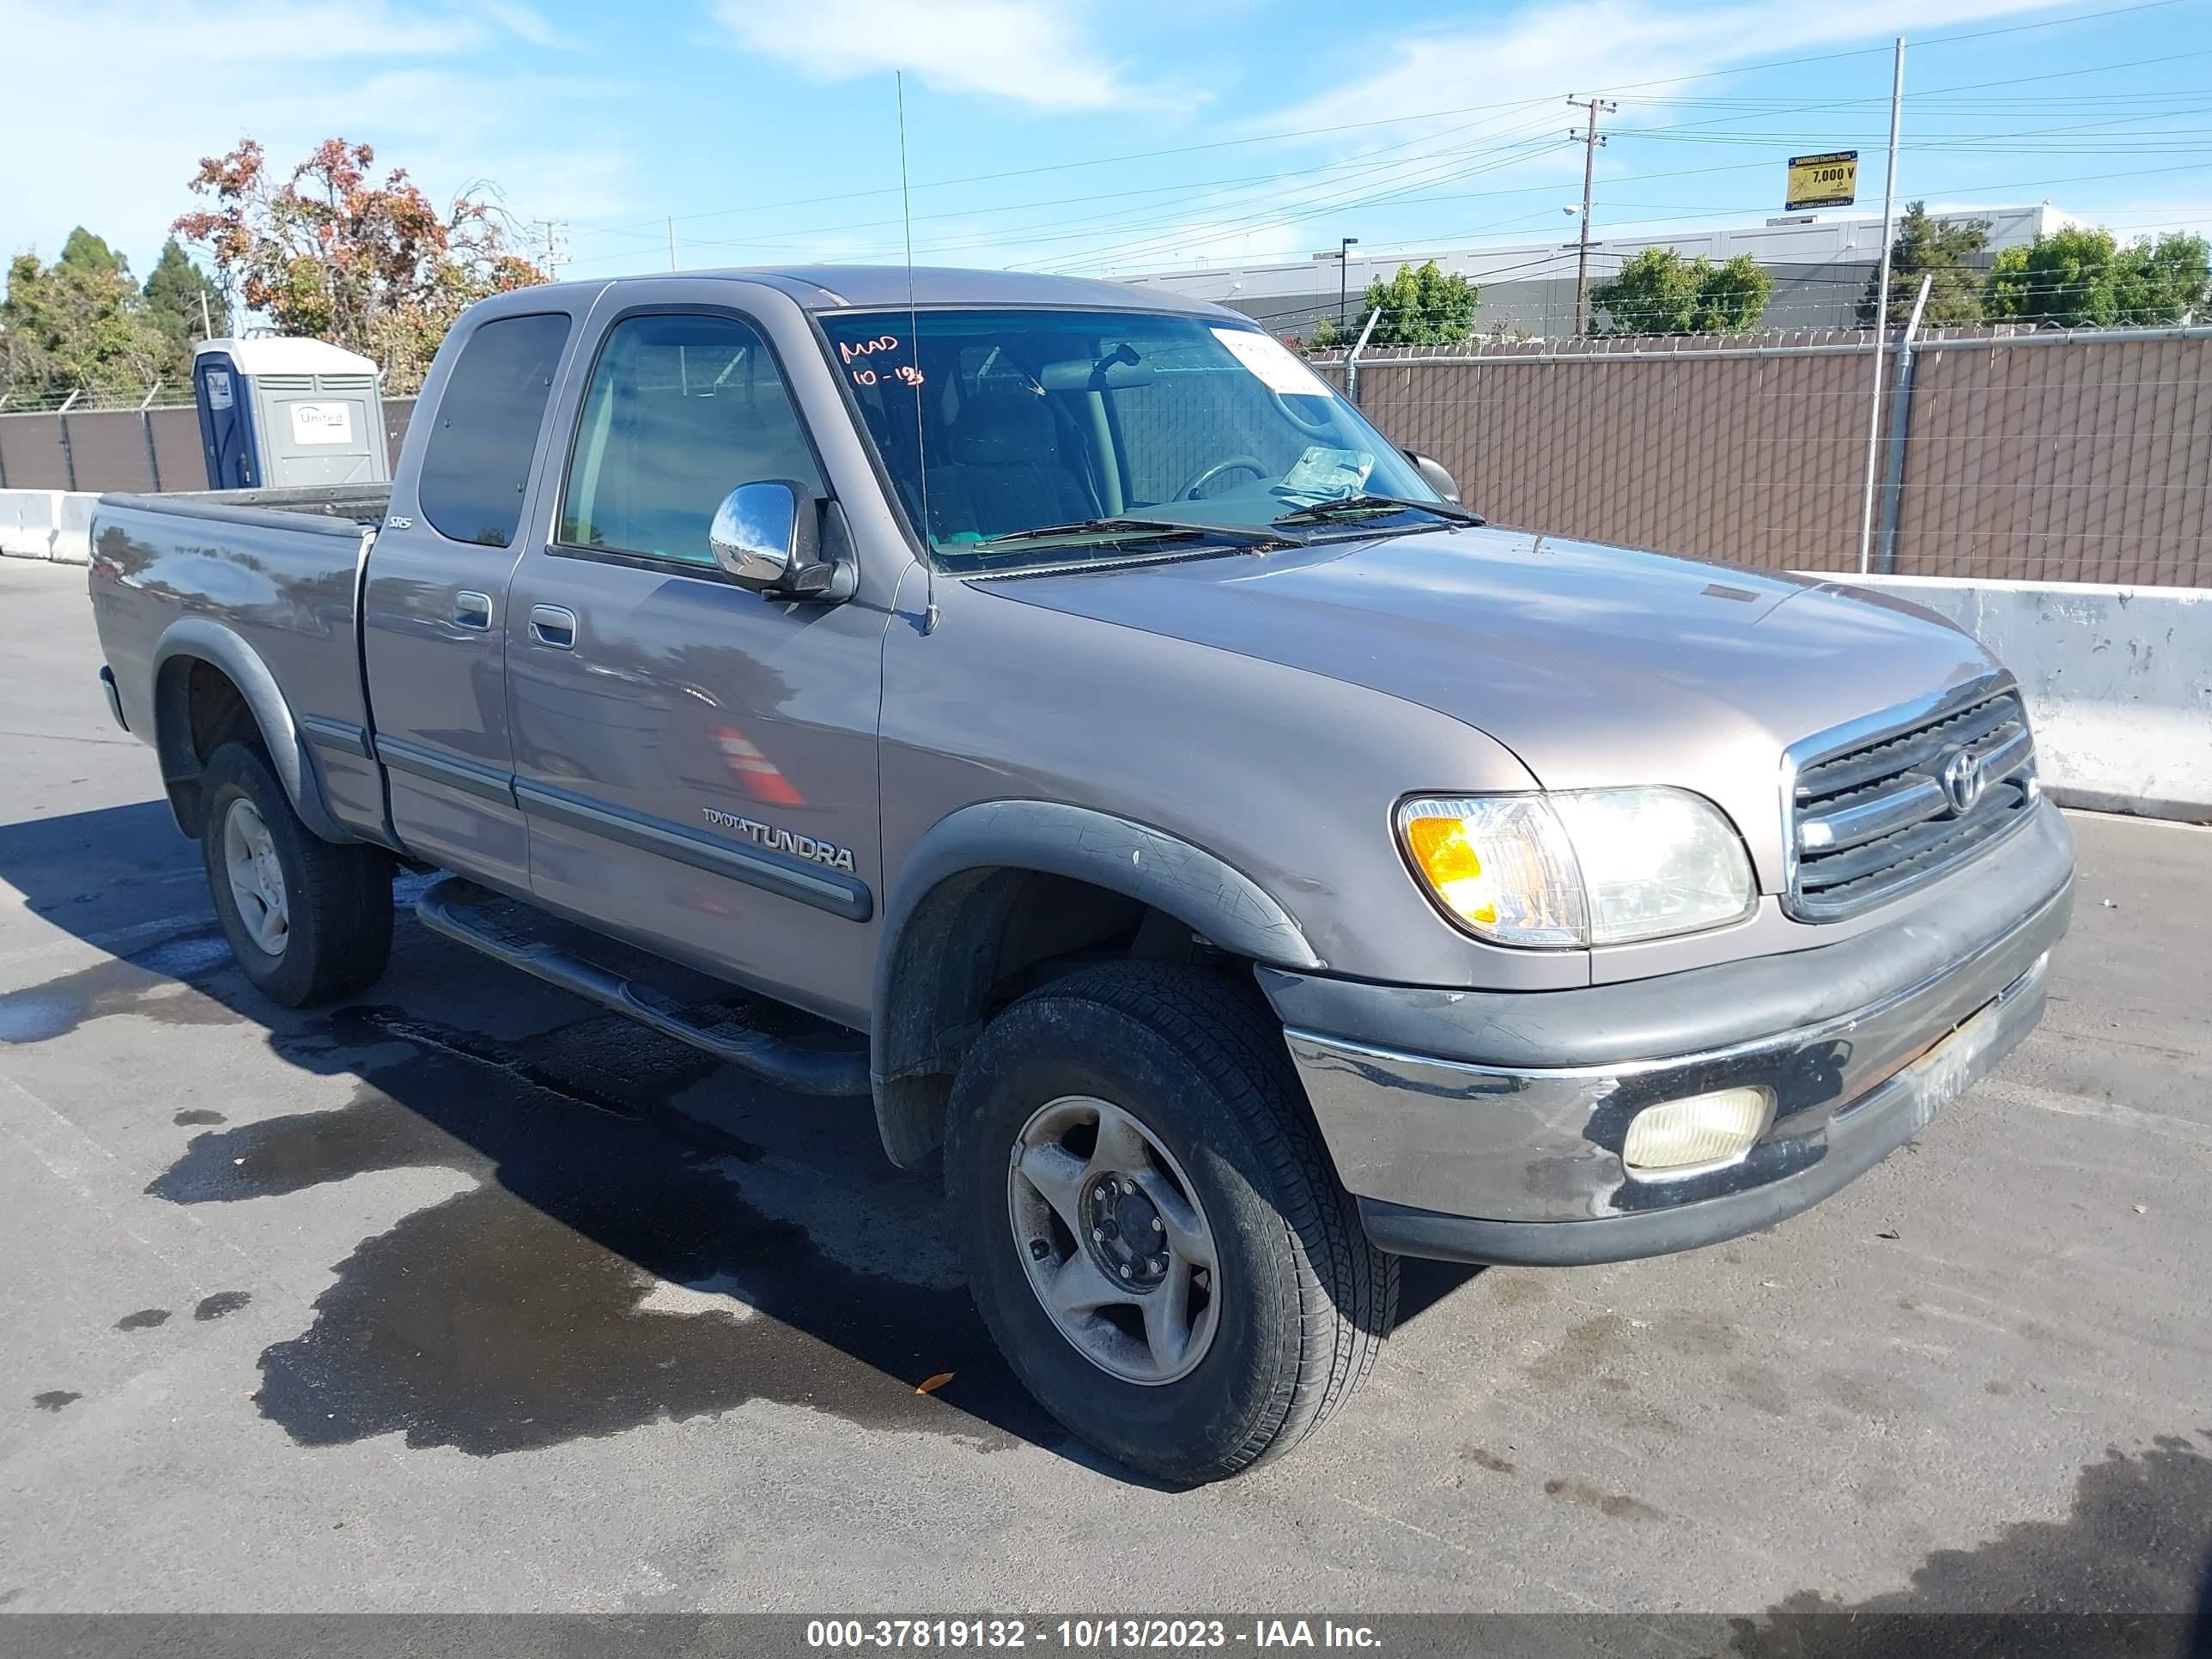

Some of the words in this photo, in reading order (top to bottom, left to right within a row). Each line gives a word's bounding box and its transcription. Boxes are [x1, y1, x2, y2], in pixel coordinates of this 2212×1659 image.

[1814, 168, 1844, 183] 7,000
[1847, 167, 1855, 179] V
[702, 808, 748, 831] TOYOTA
[745, 820, 855, 872] TUNDRA
